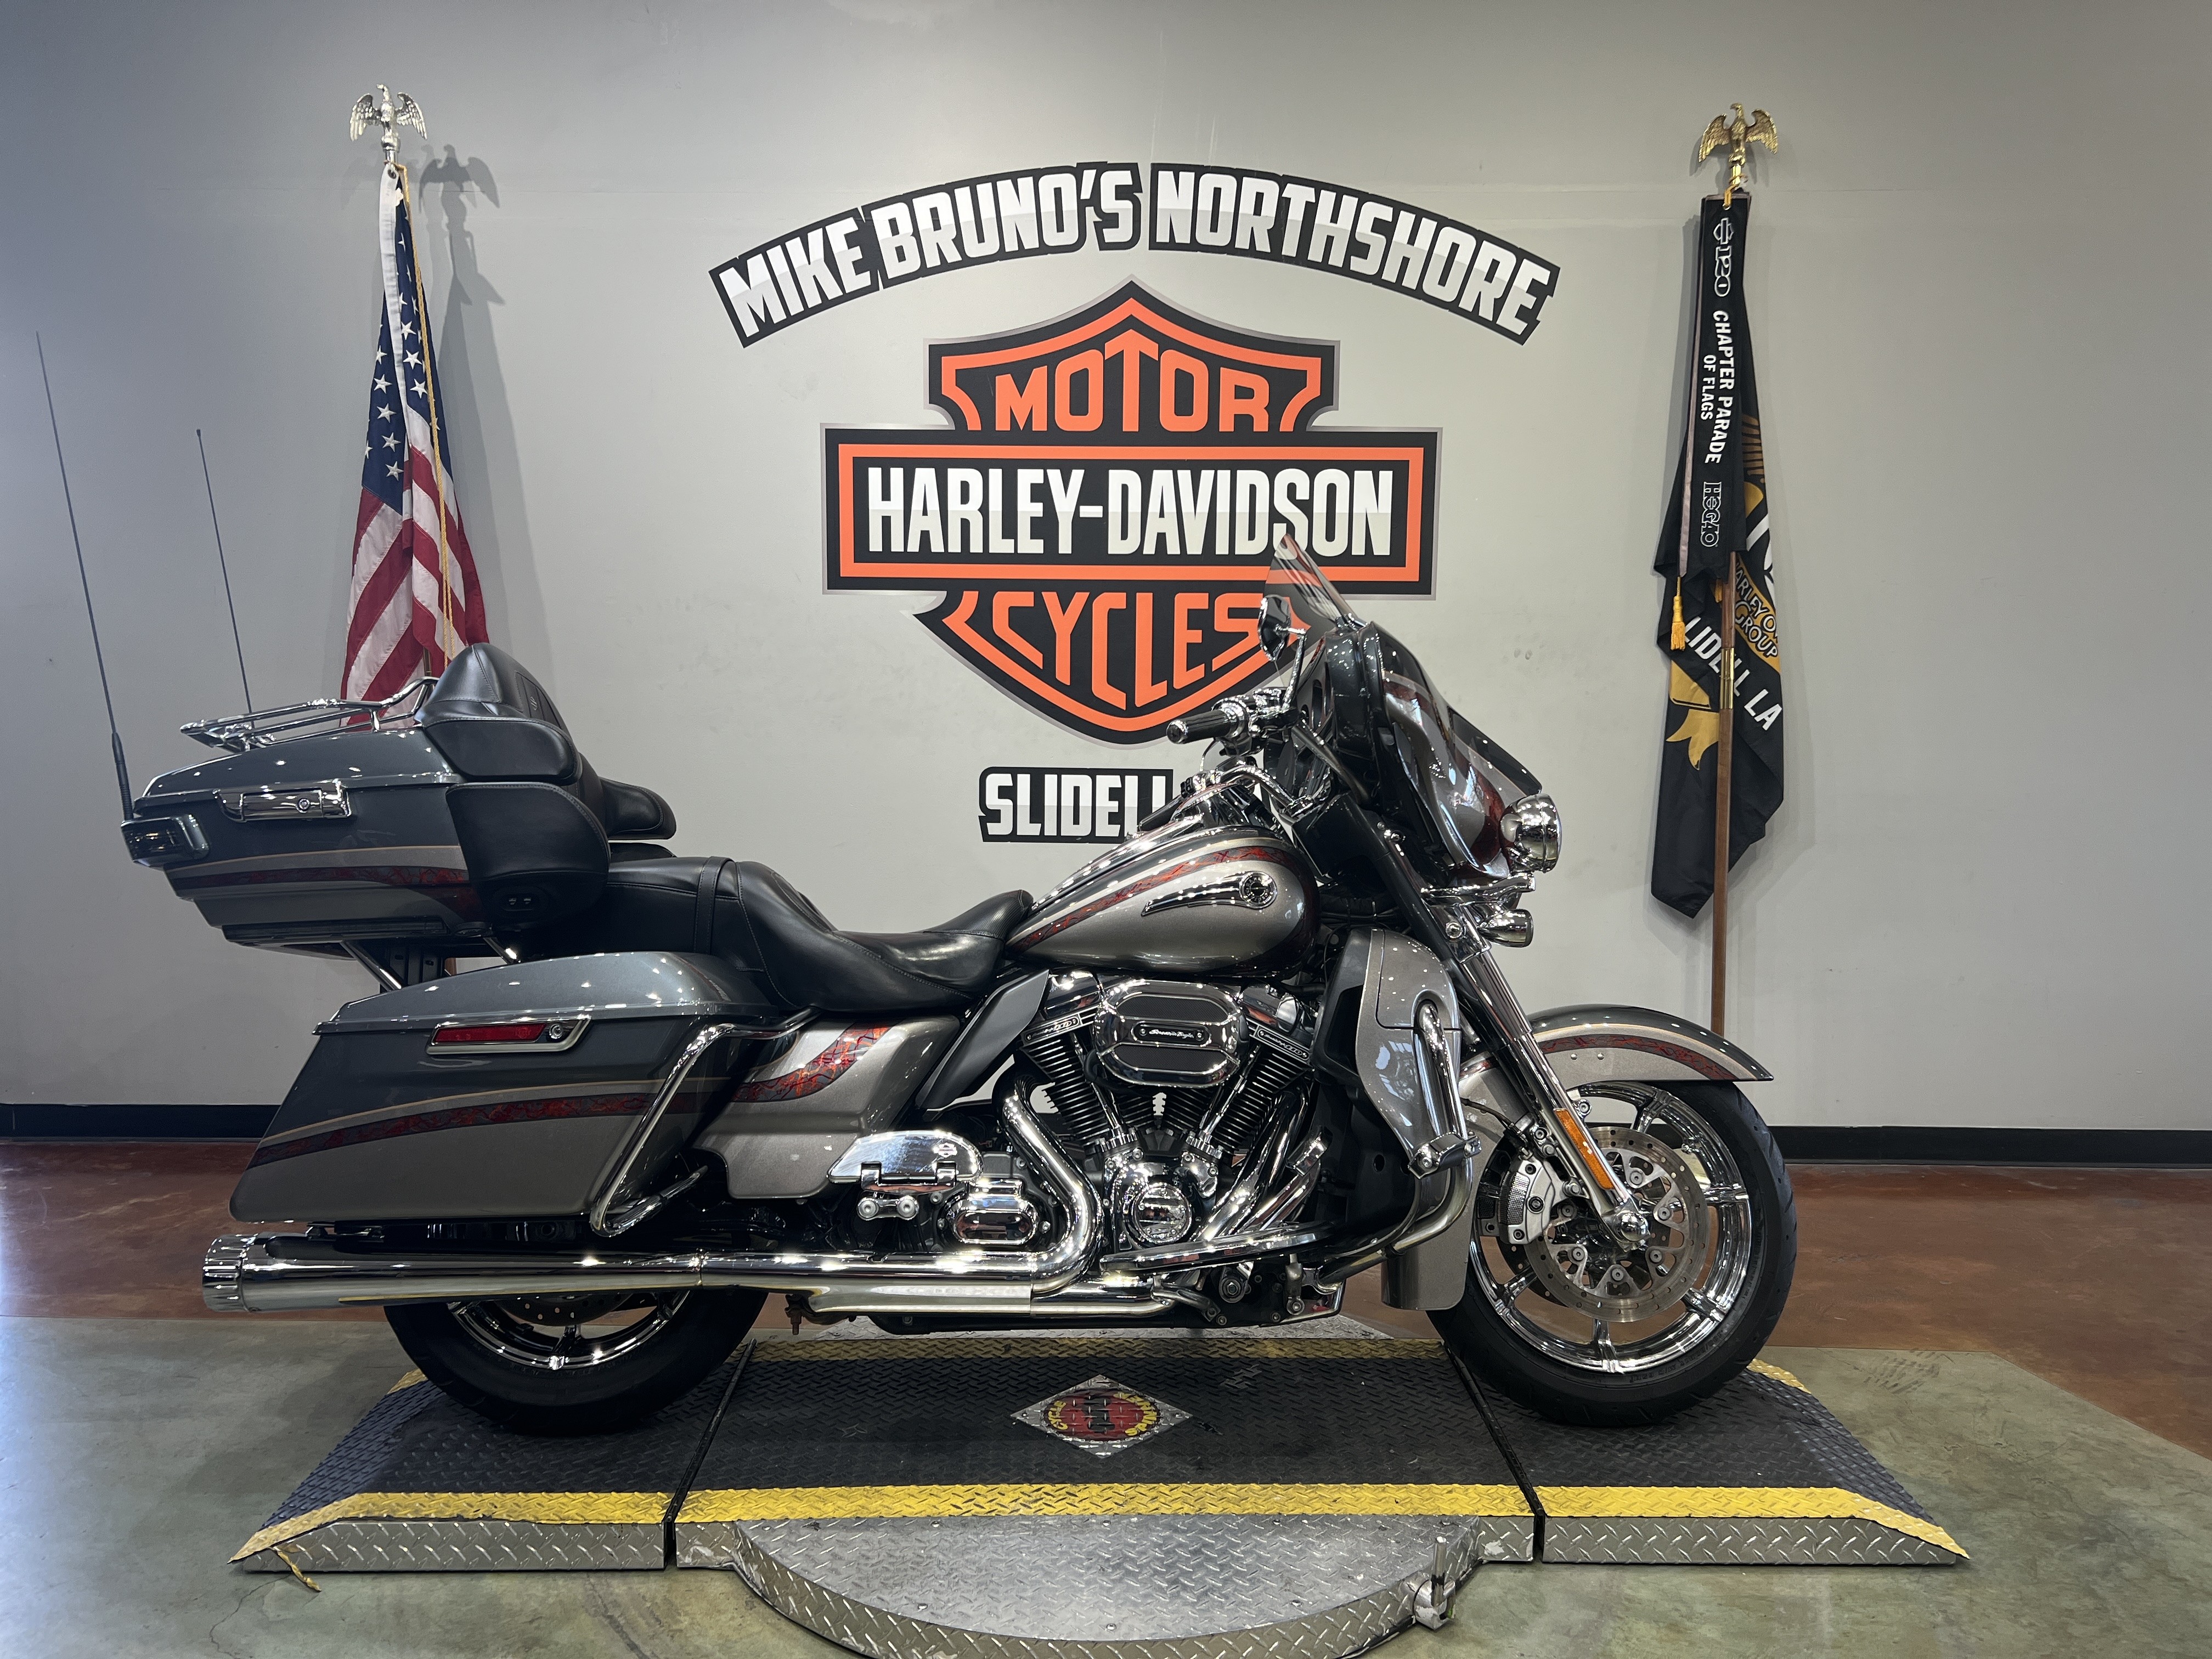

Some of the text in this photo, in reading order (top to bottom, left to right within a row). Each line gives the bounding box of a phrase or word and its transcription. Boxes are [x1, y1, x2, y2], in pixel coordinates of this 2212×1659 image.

[718, 168, 1551, 338] MIKE BRUNO'S NORTHSHORE
[1714, 245, 1732, 297] 120
[995, 328, 1270, 433] MOTOR
[1700, 354, 1717, 421] OF FLAGS
[1704, 310, 1735, 464] CHAPTER PARADE
[867, 466, 1394, 558] HARLEY-DAVIDSON
[992, 590, 1265, 710] CYCLES
[1735, 601, 1778, 658] GROUP
[1743, 689, 1782, 731] LA
[1047, 1400, 1069, 1430] CYCLE
[1113, 1391, 1158, 1436] SPINNER
